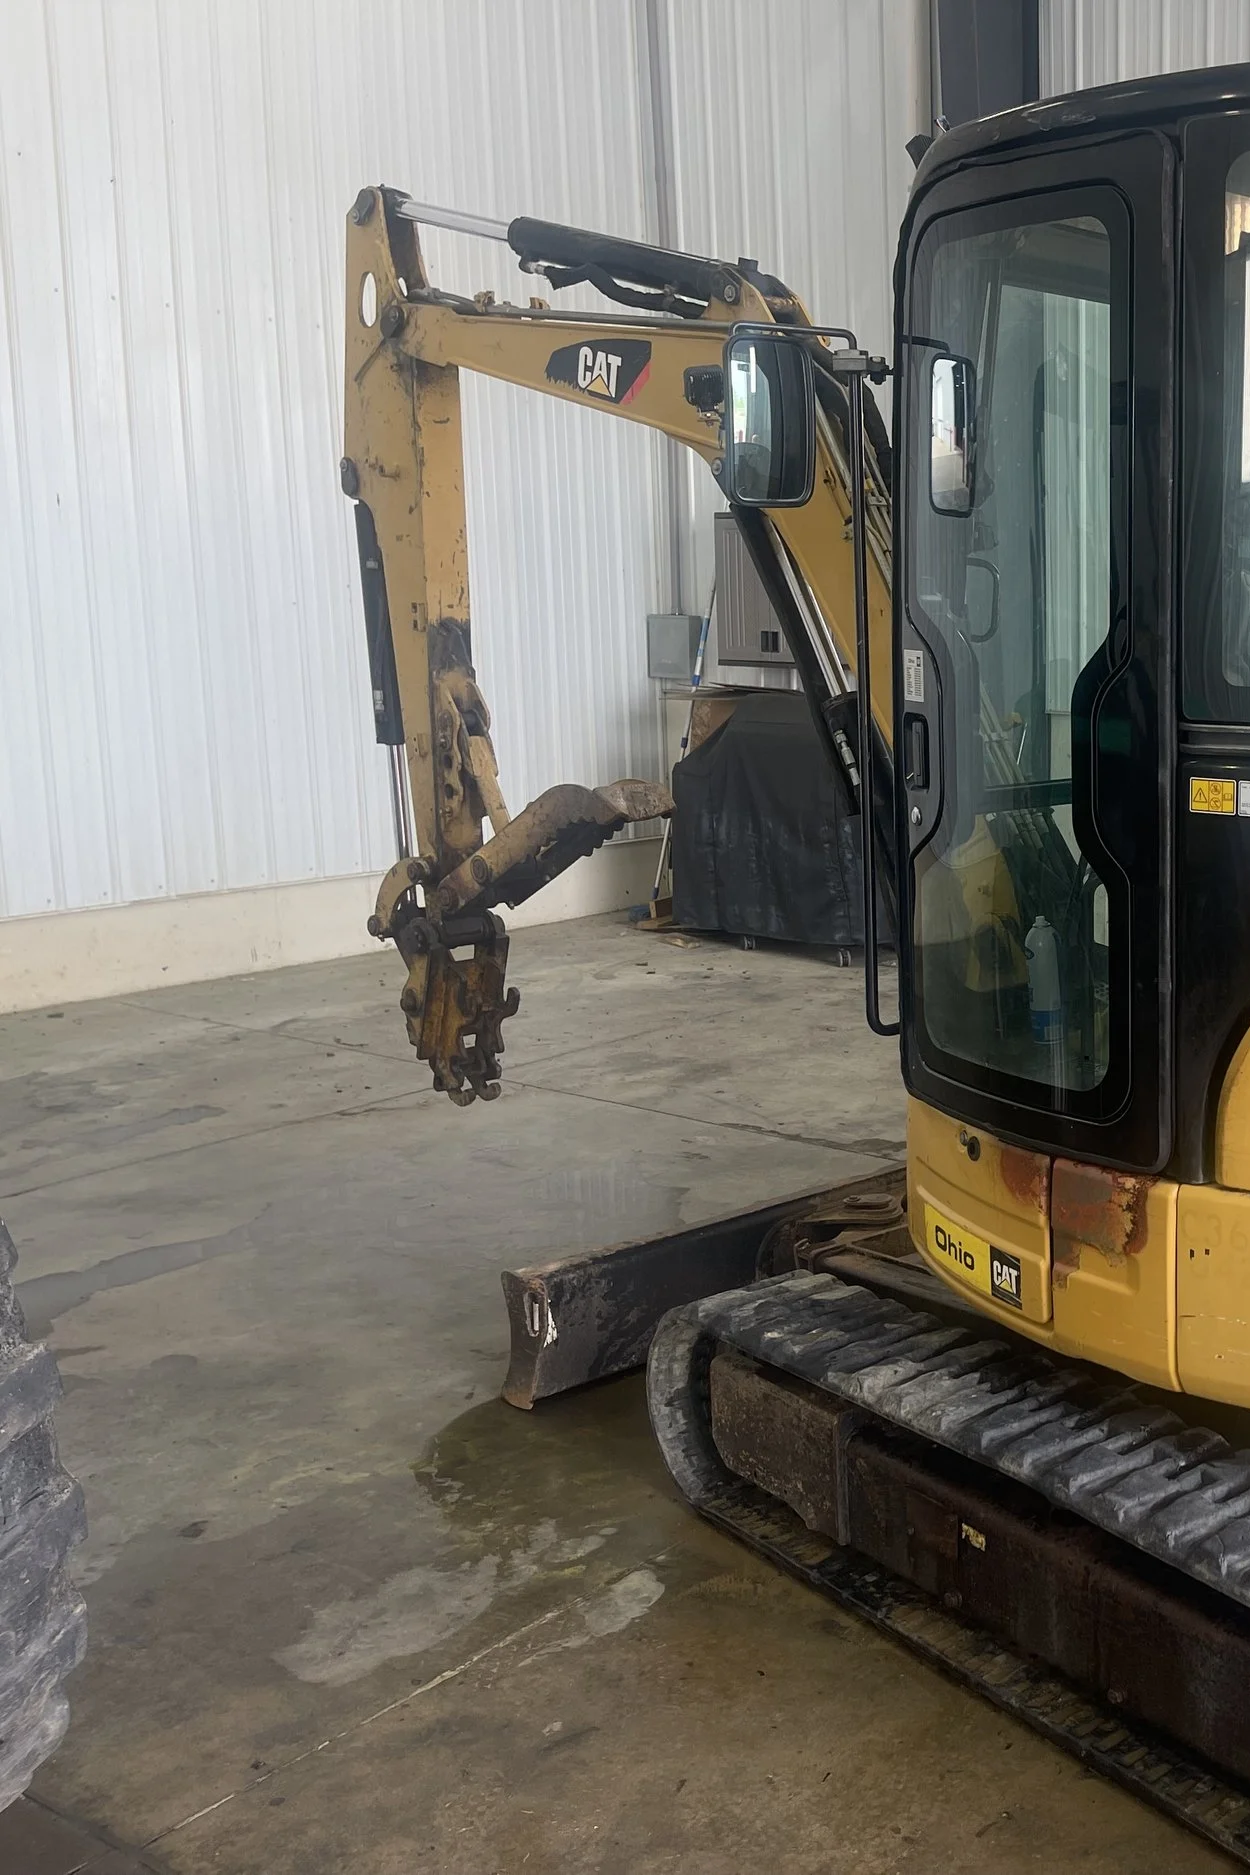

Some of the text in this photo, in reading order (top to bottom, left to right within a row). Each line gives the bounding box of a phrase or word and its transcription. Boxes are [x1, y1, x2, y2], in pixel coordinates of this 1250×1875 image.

[577, 346, 622, 398] CAT
[935, 1225, 1018, 1295] Ohio CAT
